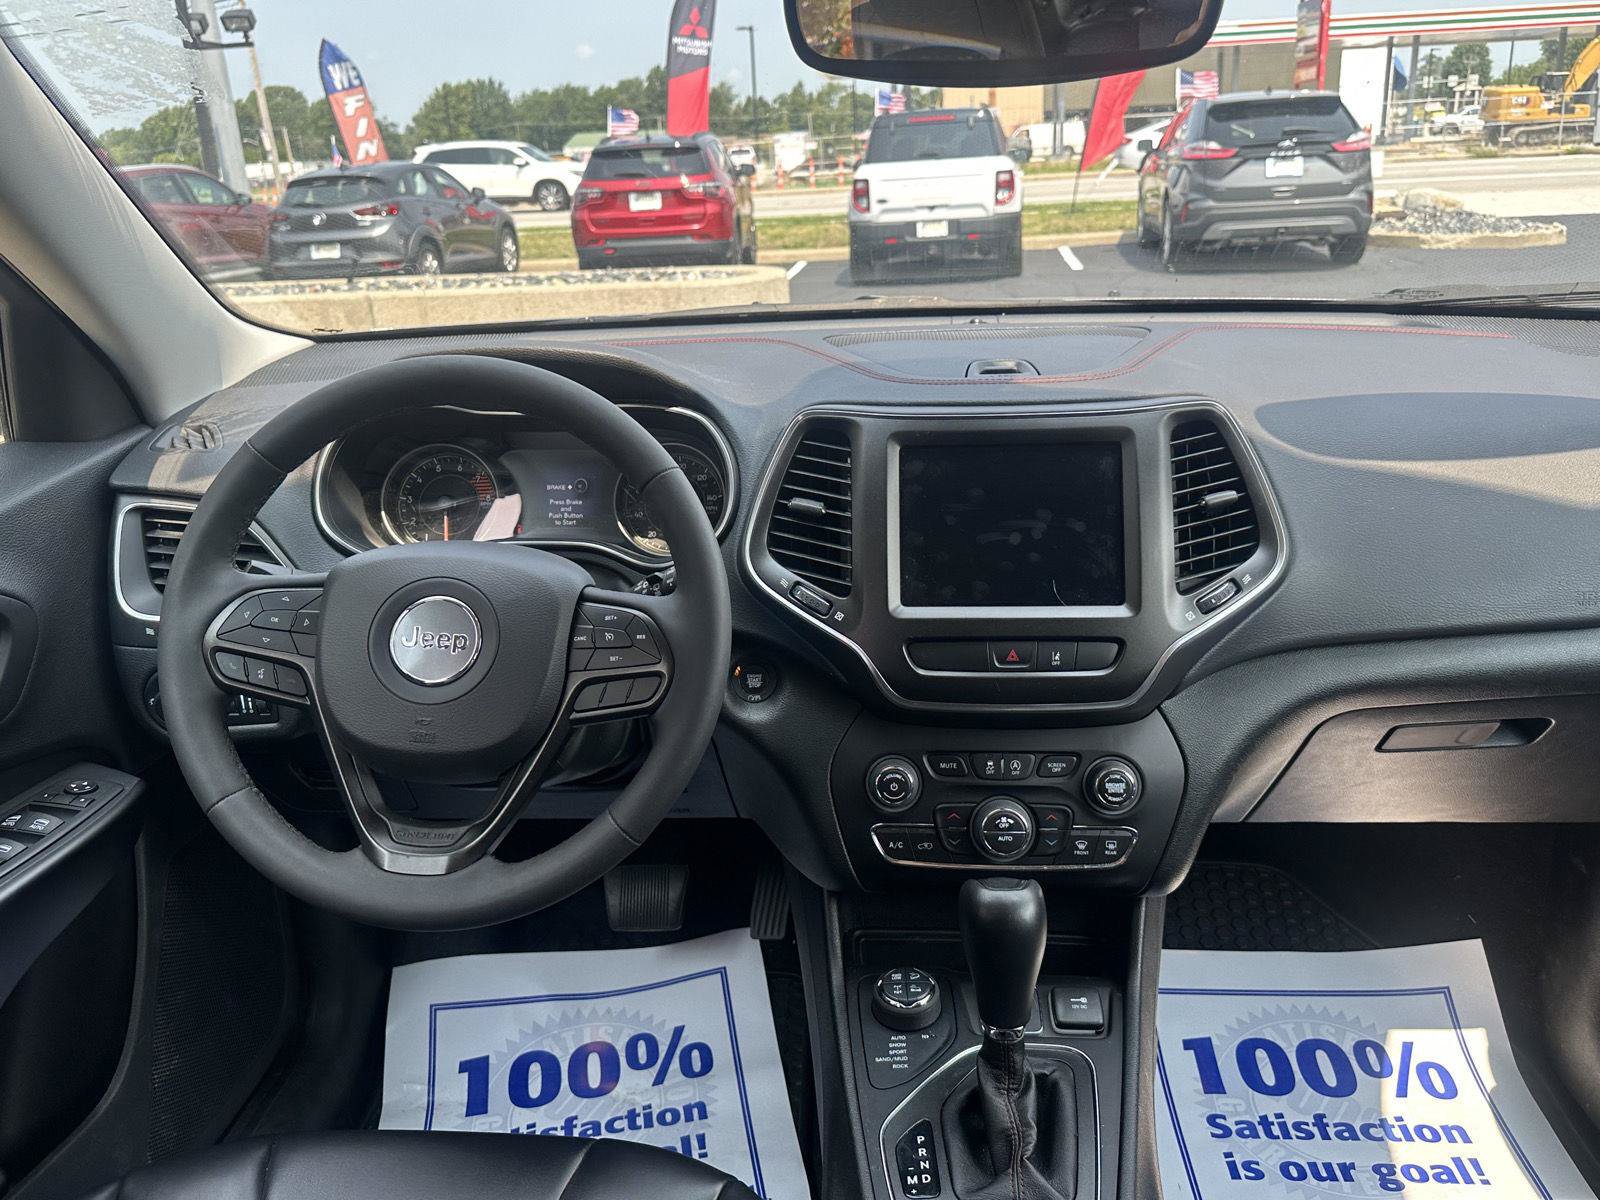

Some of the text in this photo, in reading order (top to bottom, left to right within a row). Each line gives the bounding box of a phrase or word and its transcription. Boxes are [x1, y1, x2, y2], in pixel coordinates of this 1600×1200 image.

[327, 61, 361, 91] WE
[647, 530, 657, 538] 20
[401, 625, 469, 655] Jeep
[888, 841, 904, 849] A/C
[875, 1055, 909, 1063] SAND/MUD
[458, 1025, 714, 1117] 100%
[1182, 1036, 1460, 1100] 100%
[1205, 1112, 1473, 1145] Satisfaction
[917, 1135, 925, 1145] P
[918, 1147, 928, 1157] R
[920, 1160, 930, 1170] N
[1223, 1151, 1492, 1193] is our goal!
[906, 1174, 919, 1185] M
[921, 1174, 932, 1184] D
